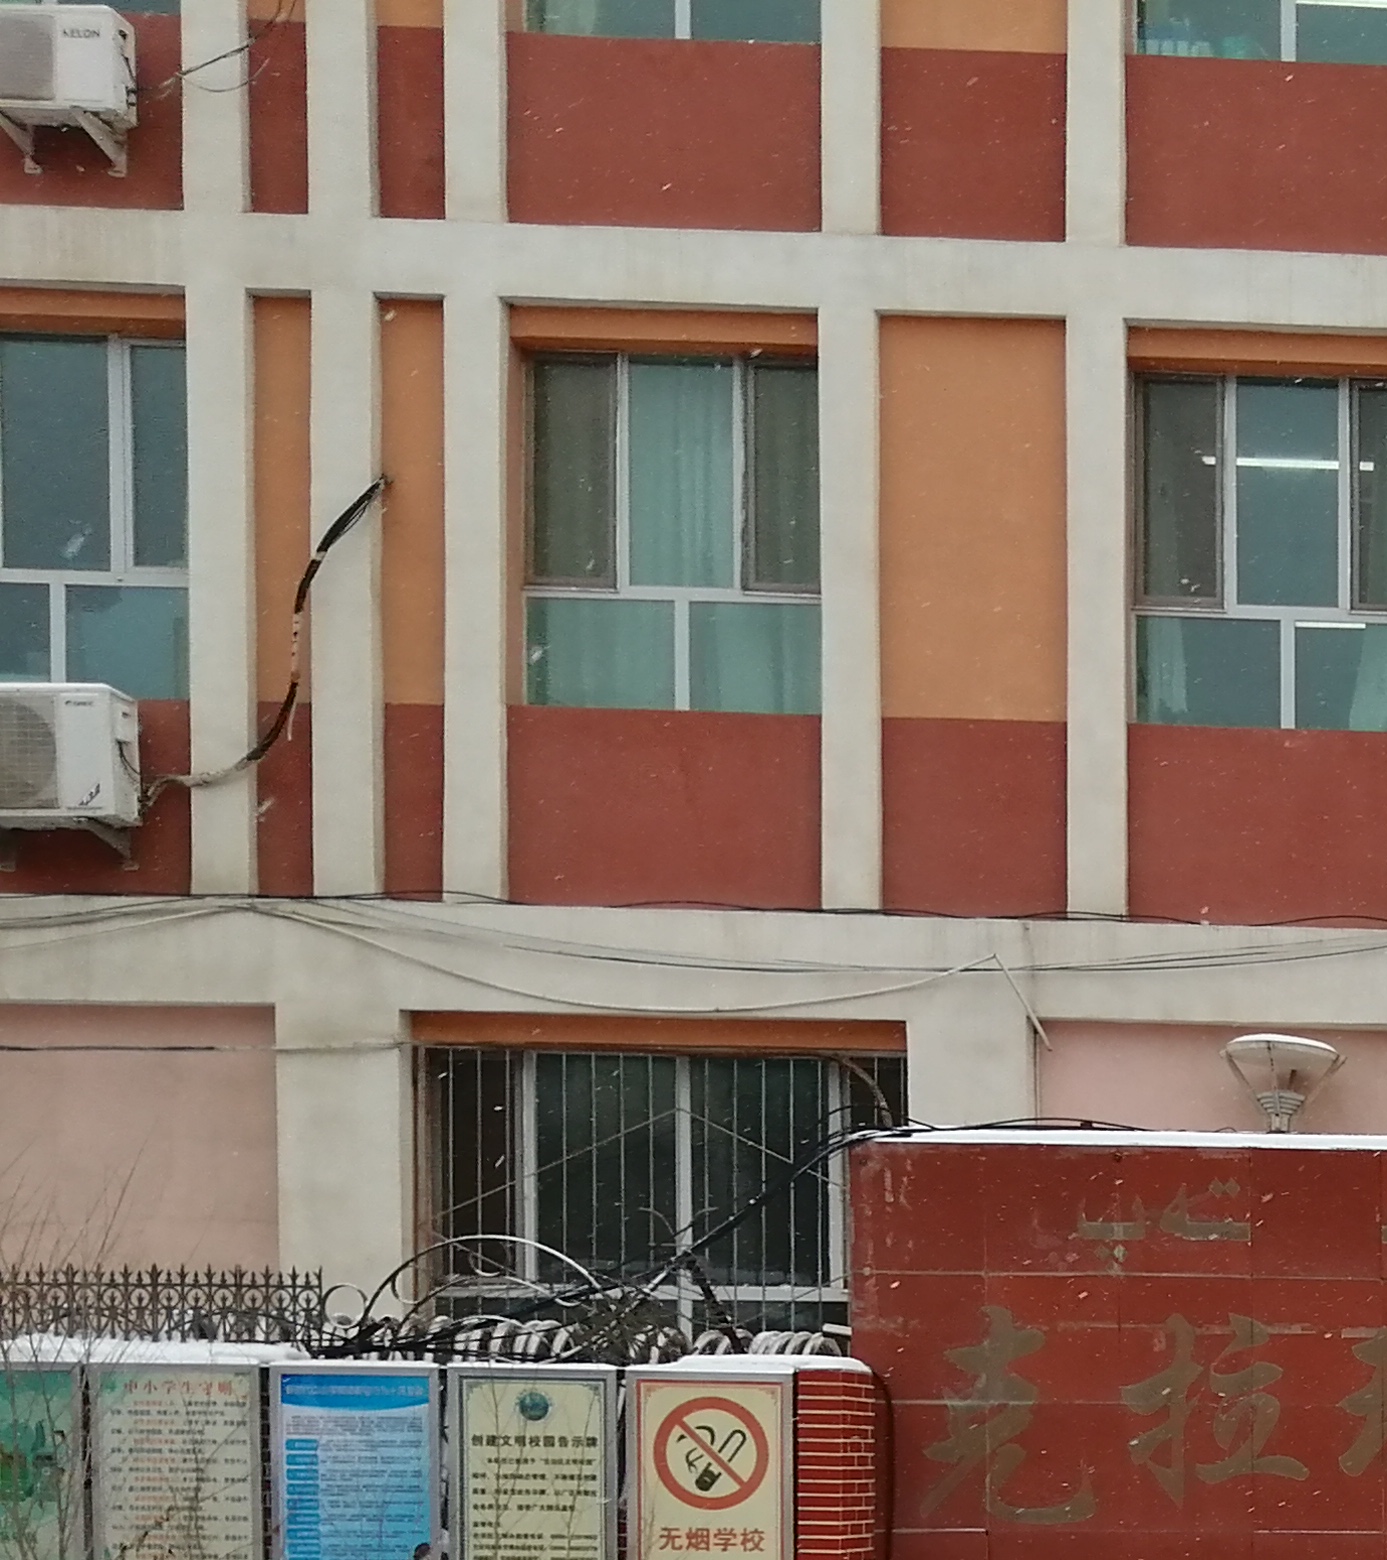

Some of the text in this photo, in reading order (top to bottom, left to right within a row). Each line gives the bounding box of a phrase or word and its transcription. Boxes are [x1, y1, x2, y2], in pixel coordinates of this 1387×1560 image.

[123, 1378, 233, 1396] 中小学生守则
[658, 1526, 766, 1552] 无烟学校
